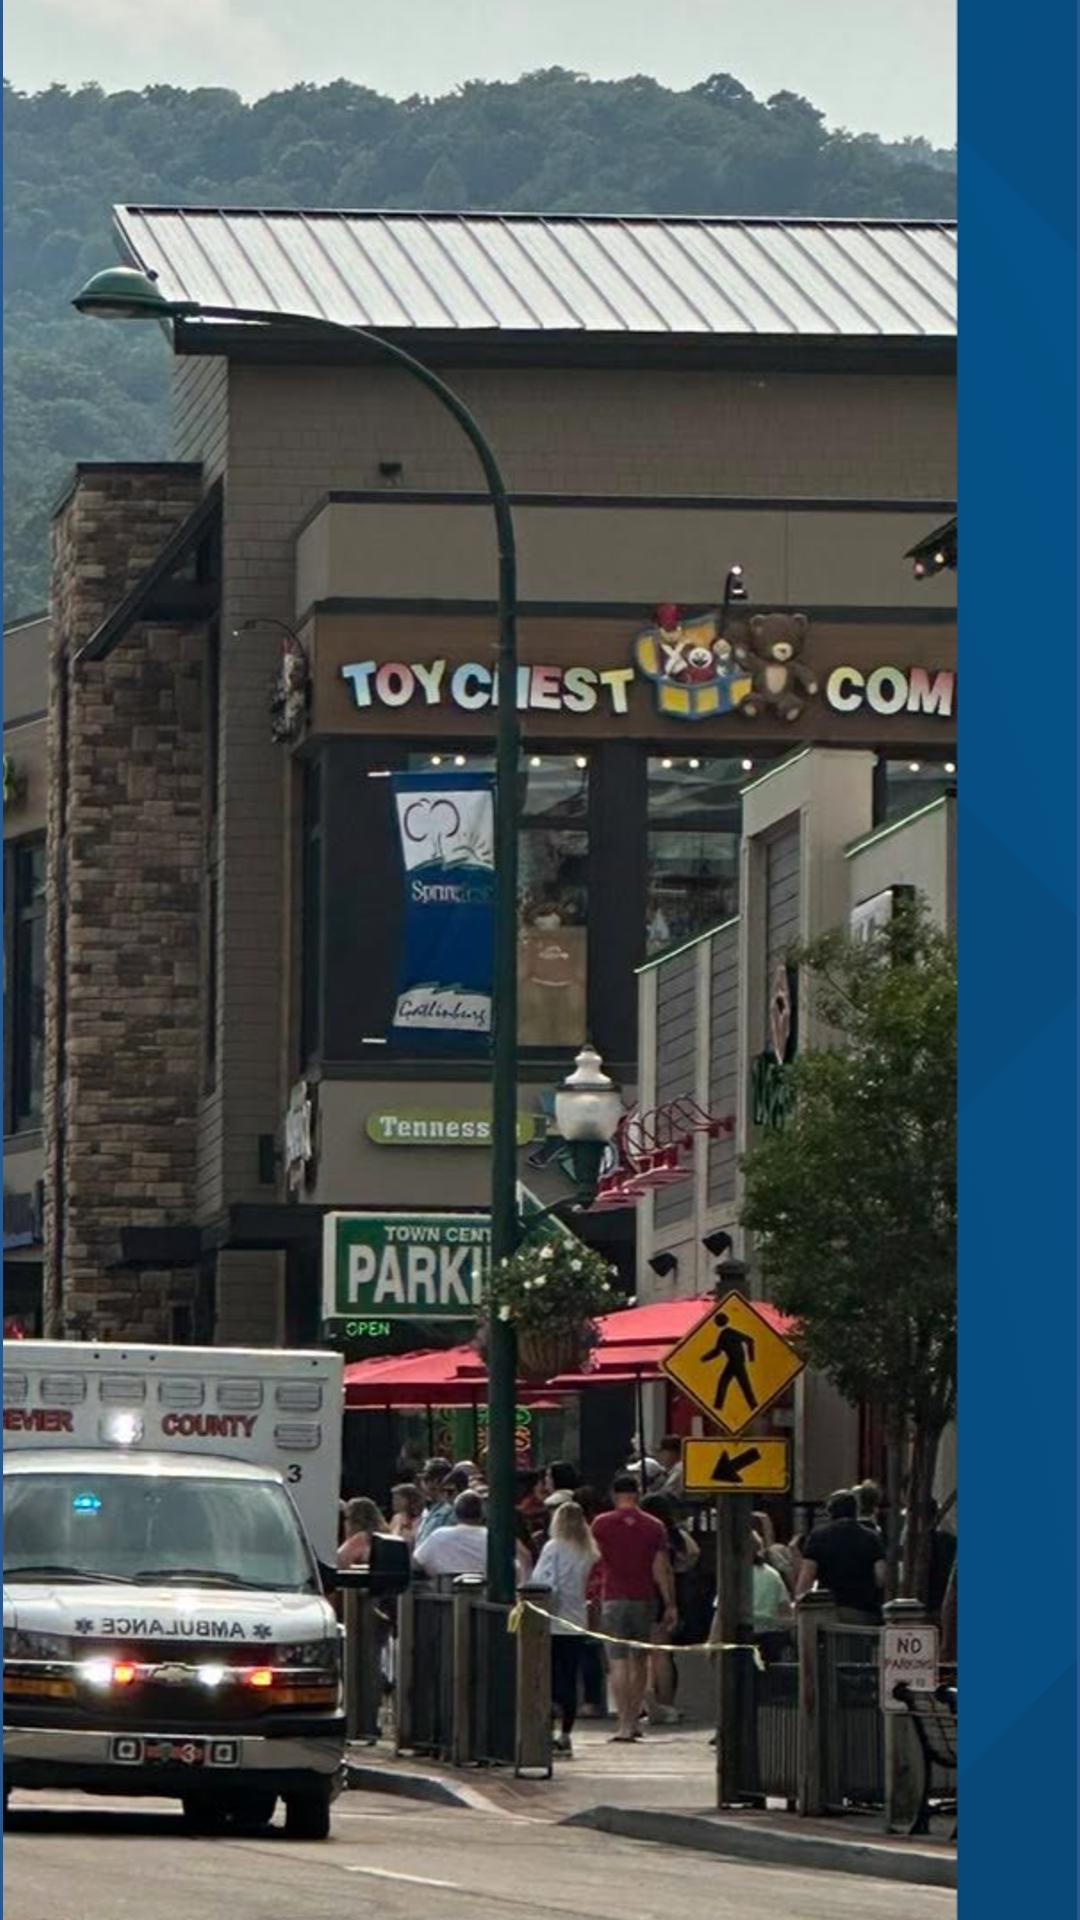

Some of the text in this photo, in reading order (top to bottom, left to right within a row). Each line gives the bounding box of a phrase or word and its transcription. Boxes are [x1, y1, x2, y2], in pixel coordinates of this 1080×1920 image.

[342, 660, 445, 707] TOY
[826, 666, 954, 716] COM
[384, 1226, 493, 1243] TOWN CENT
[349, 1245, 492, 1304] PARKI
[346, 1322, 390, 1336] OPEN
[162, 1413, 257, 1438] COUNTY
[288, 1464, 302, 1483] 3
[897, 1637, 922, 1654] NO
